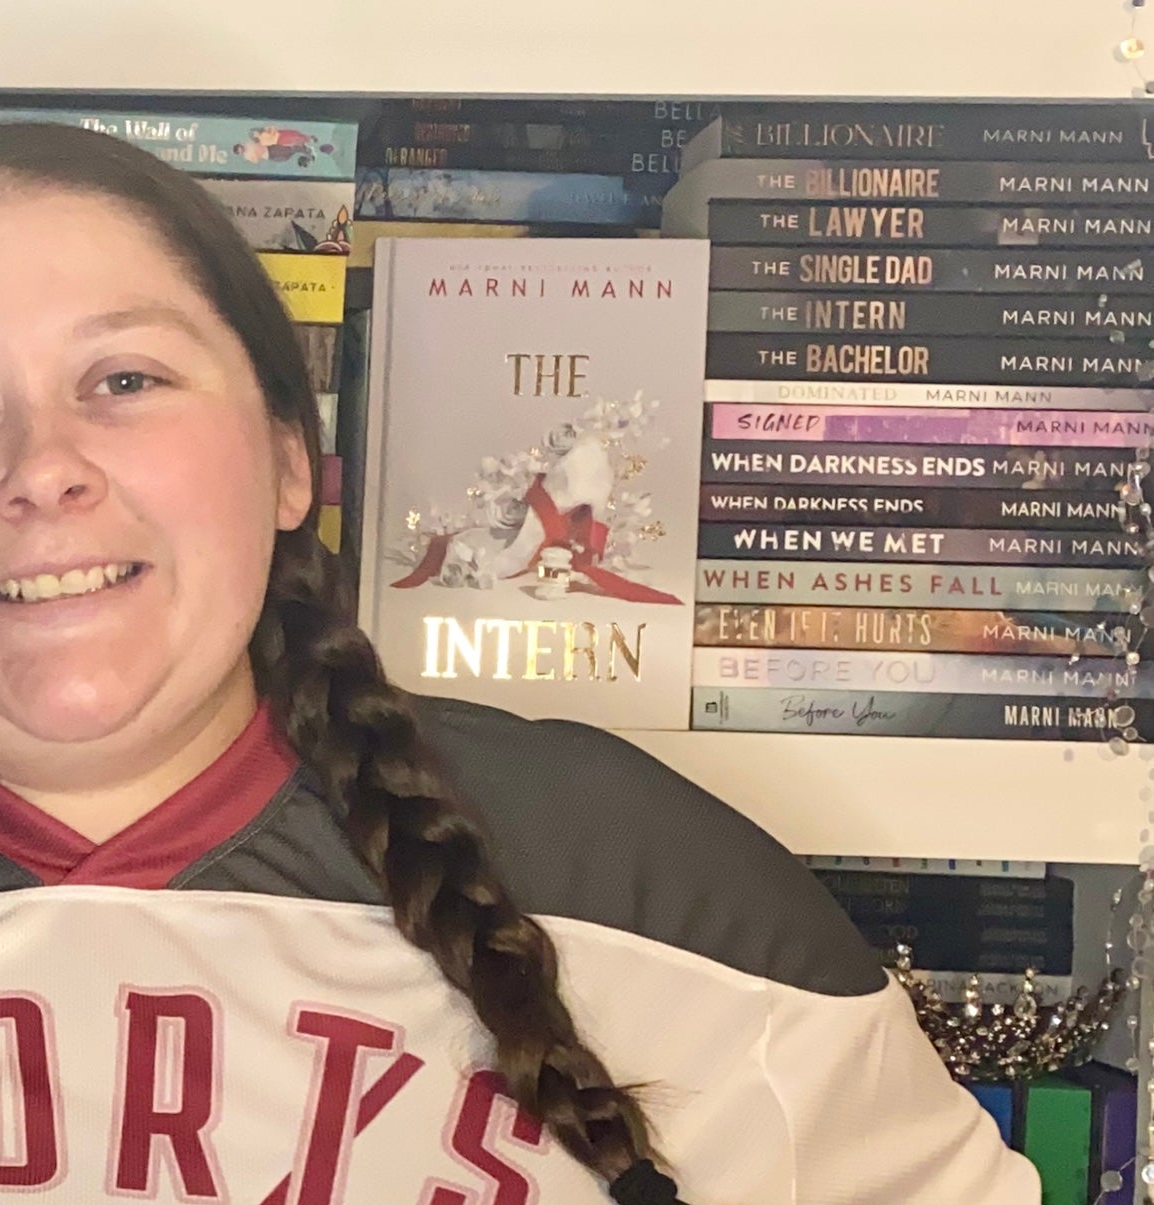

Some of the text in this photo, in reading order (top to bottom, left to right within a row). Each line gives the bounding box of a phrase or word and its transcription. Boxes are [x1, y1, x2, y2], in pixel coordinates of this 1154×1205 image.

[176, 123, 199, 140] of
[984, 129, 1122, 144] MARNI MANN
[757, 169, 1149, 197] THE BILLIONAIRE MARNI MANN
[264, 207, 326, 219] ZAPATA
[761, 207, 1151, 238] THE LAWYER MARNI MANN
[752, 255, 1144, 285] THE SINGLE DAD MARNI MANN
[429, 278, 674, 299] MARNI MANN
[761, 300, 1152, 330] THE INTERN MARNI MANN
[758, 345, 1072, 375] THE BACHELOR MARNI
[506, 354, 590, 397] THE
[737, 414, 821, 432] SIGNED
[712, 453, 1064, 477] WHEN DARKNESS ENDS MARNI
[1001, 502, 1060, 517] MARNI
[733, 529, 1061, 554] WHEN WE MET MARNI
[704, 570, 1003, 596] WHEN ASHES FALL
[983, 624, 1055, 640] MARNI
[421, 616, 647, 683] INTERN
[982, 668, 1054, 684] MARNI
[781, 695, 1059, 730] Before You MARNI
